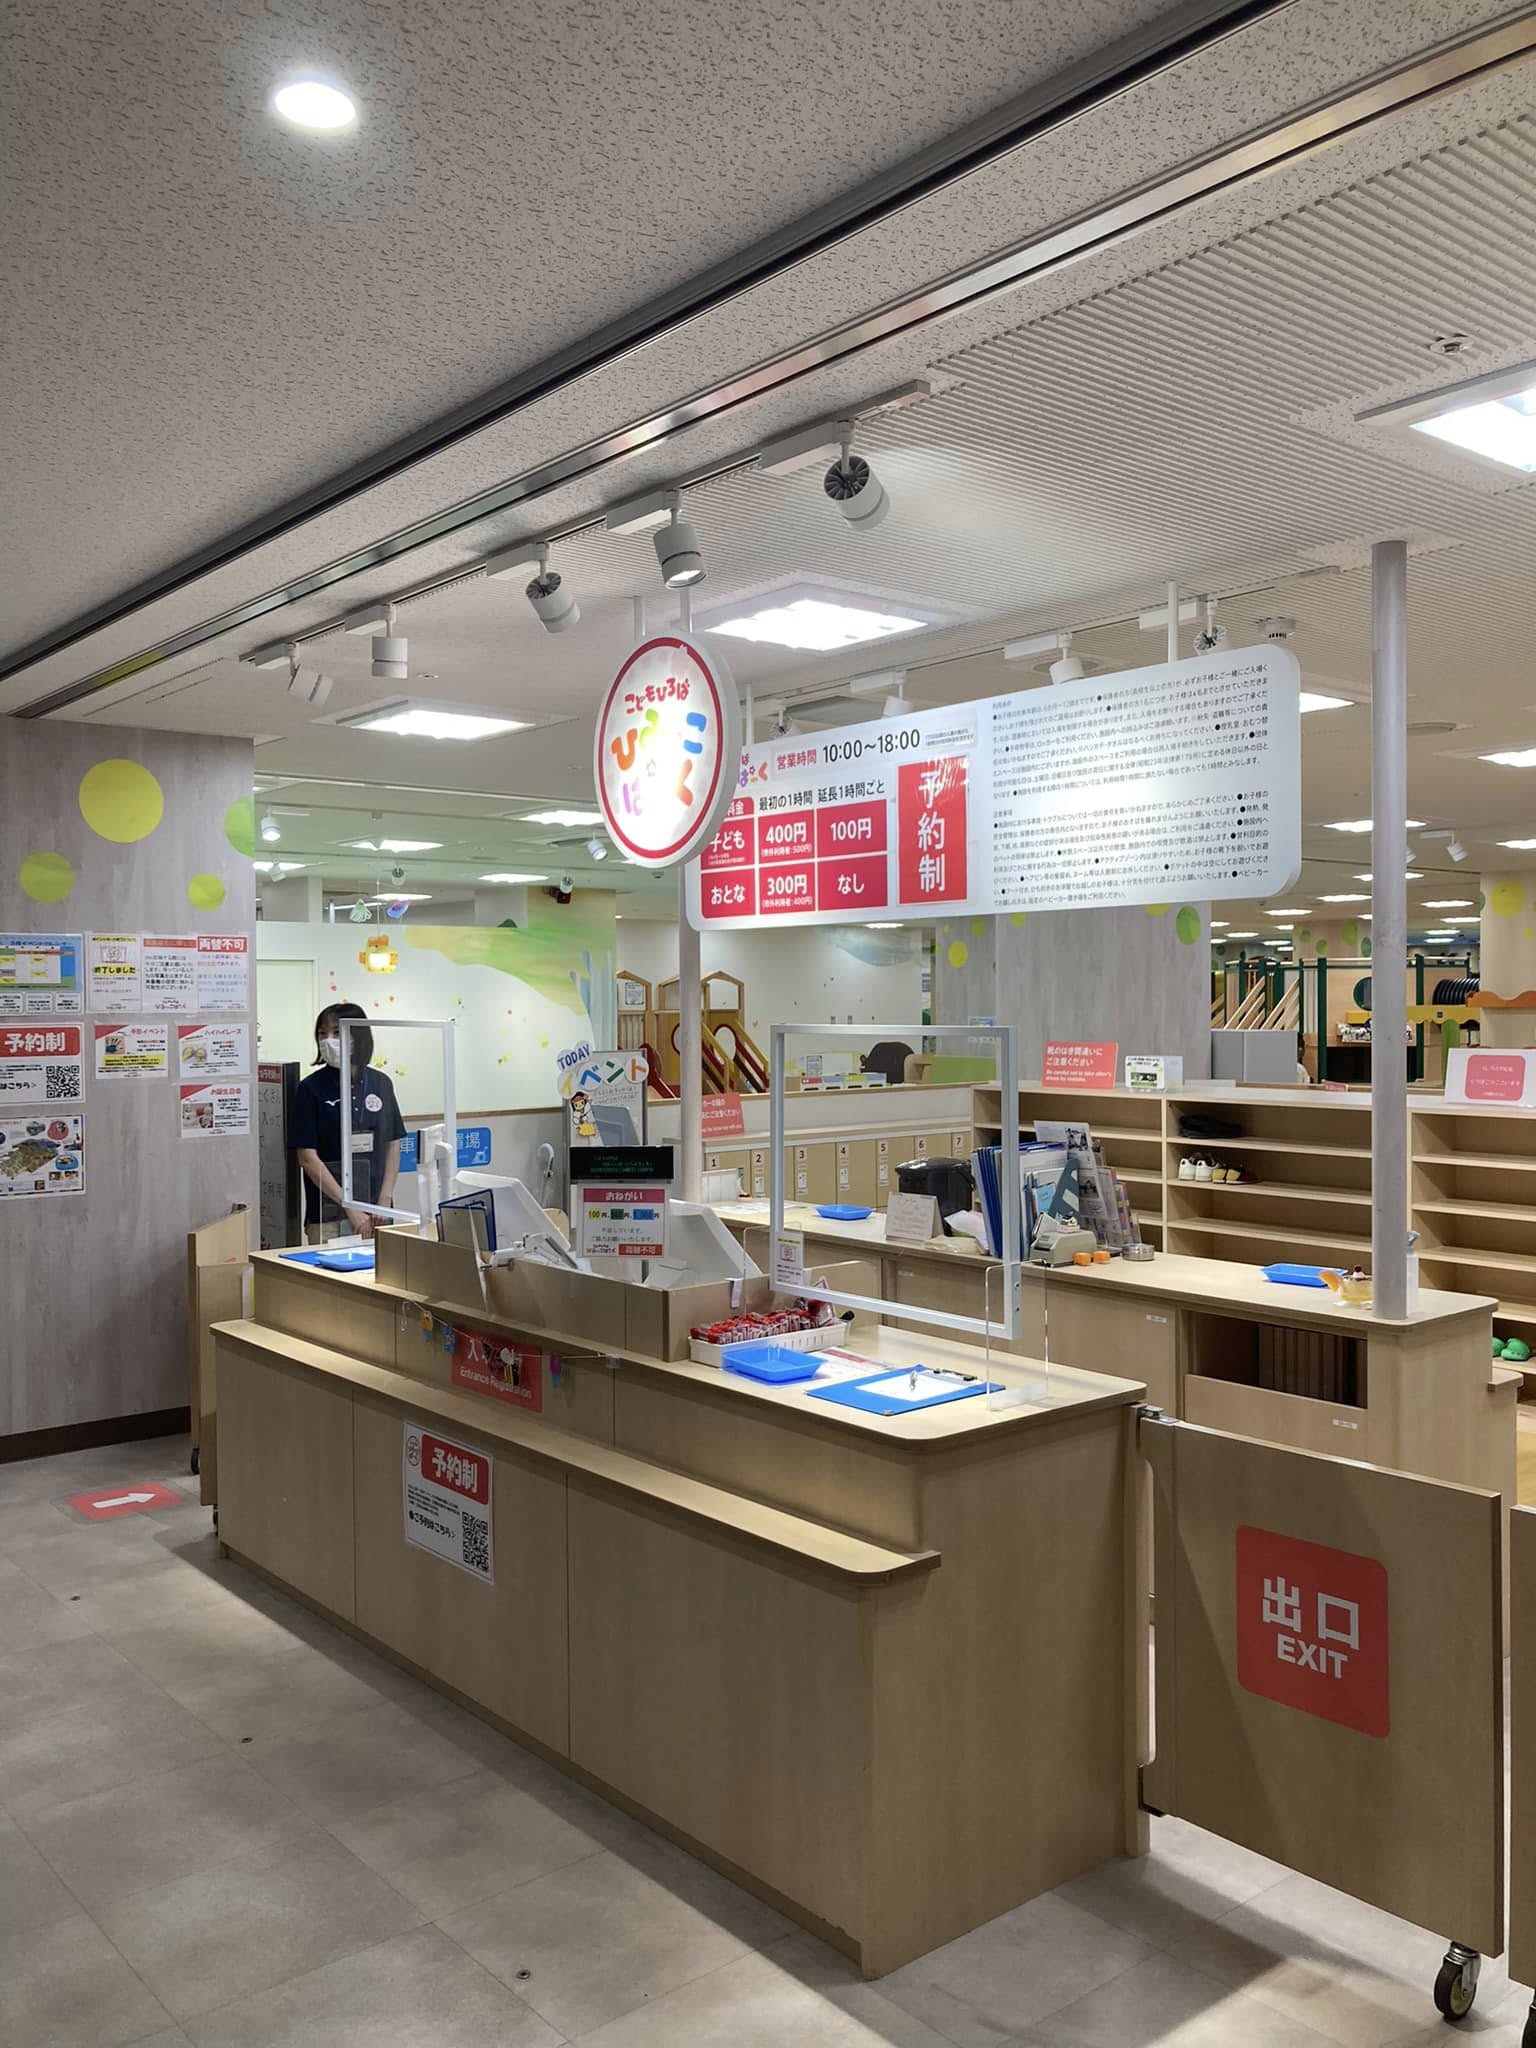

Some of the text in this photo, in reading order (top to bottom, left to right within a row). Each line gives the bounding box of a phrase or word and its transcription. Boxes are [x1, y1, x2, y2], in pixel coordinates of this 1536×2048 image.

[625, 677, 690, 714] こどもひろば
[776, 749, 817, 770] 営業時間
[759, 780, 886, 812] 最初の1時間 延長1時間ごと
[765, 821, 807, 844] 400円
[830, 819, 872, 842] 100円
[917, 766, 946, 894] 予約制
[710, 830, 745, 853] 子ども
[711, 883, 746, 905] おとな
[767, 874, 807, 896] 300円
[837, 872, 865, 894] なし
[199, 939, 245, 951] 両替不可
[4, 1031, 66, 1053] 予約制
[558, 1044, 591, 1070] TODAY
[561, 1058, 647, 1097] イベント
[840, 1147, 846, 1155] 4
[880, 1143, 886, 1152] 5
[918, 1140, 924, 1149] 6
[956, 1136, 961, 1145] 7
[711, 1158, 716, 1167] 1
[756, 1154, 762, 1163] 2
[799, 1150, 805, 1159] 3
[460, 1366, 489, 1384] Entrance
[432, 1447, 478, 1494] 予約制
[1263, 1575, 1360, 1650] 出口
[1276, 1633, 1348, 1680] EXIT
